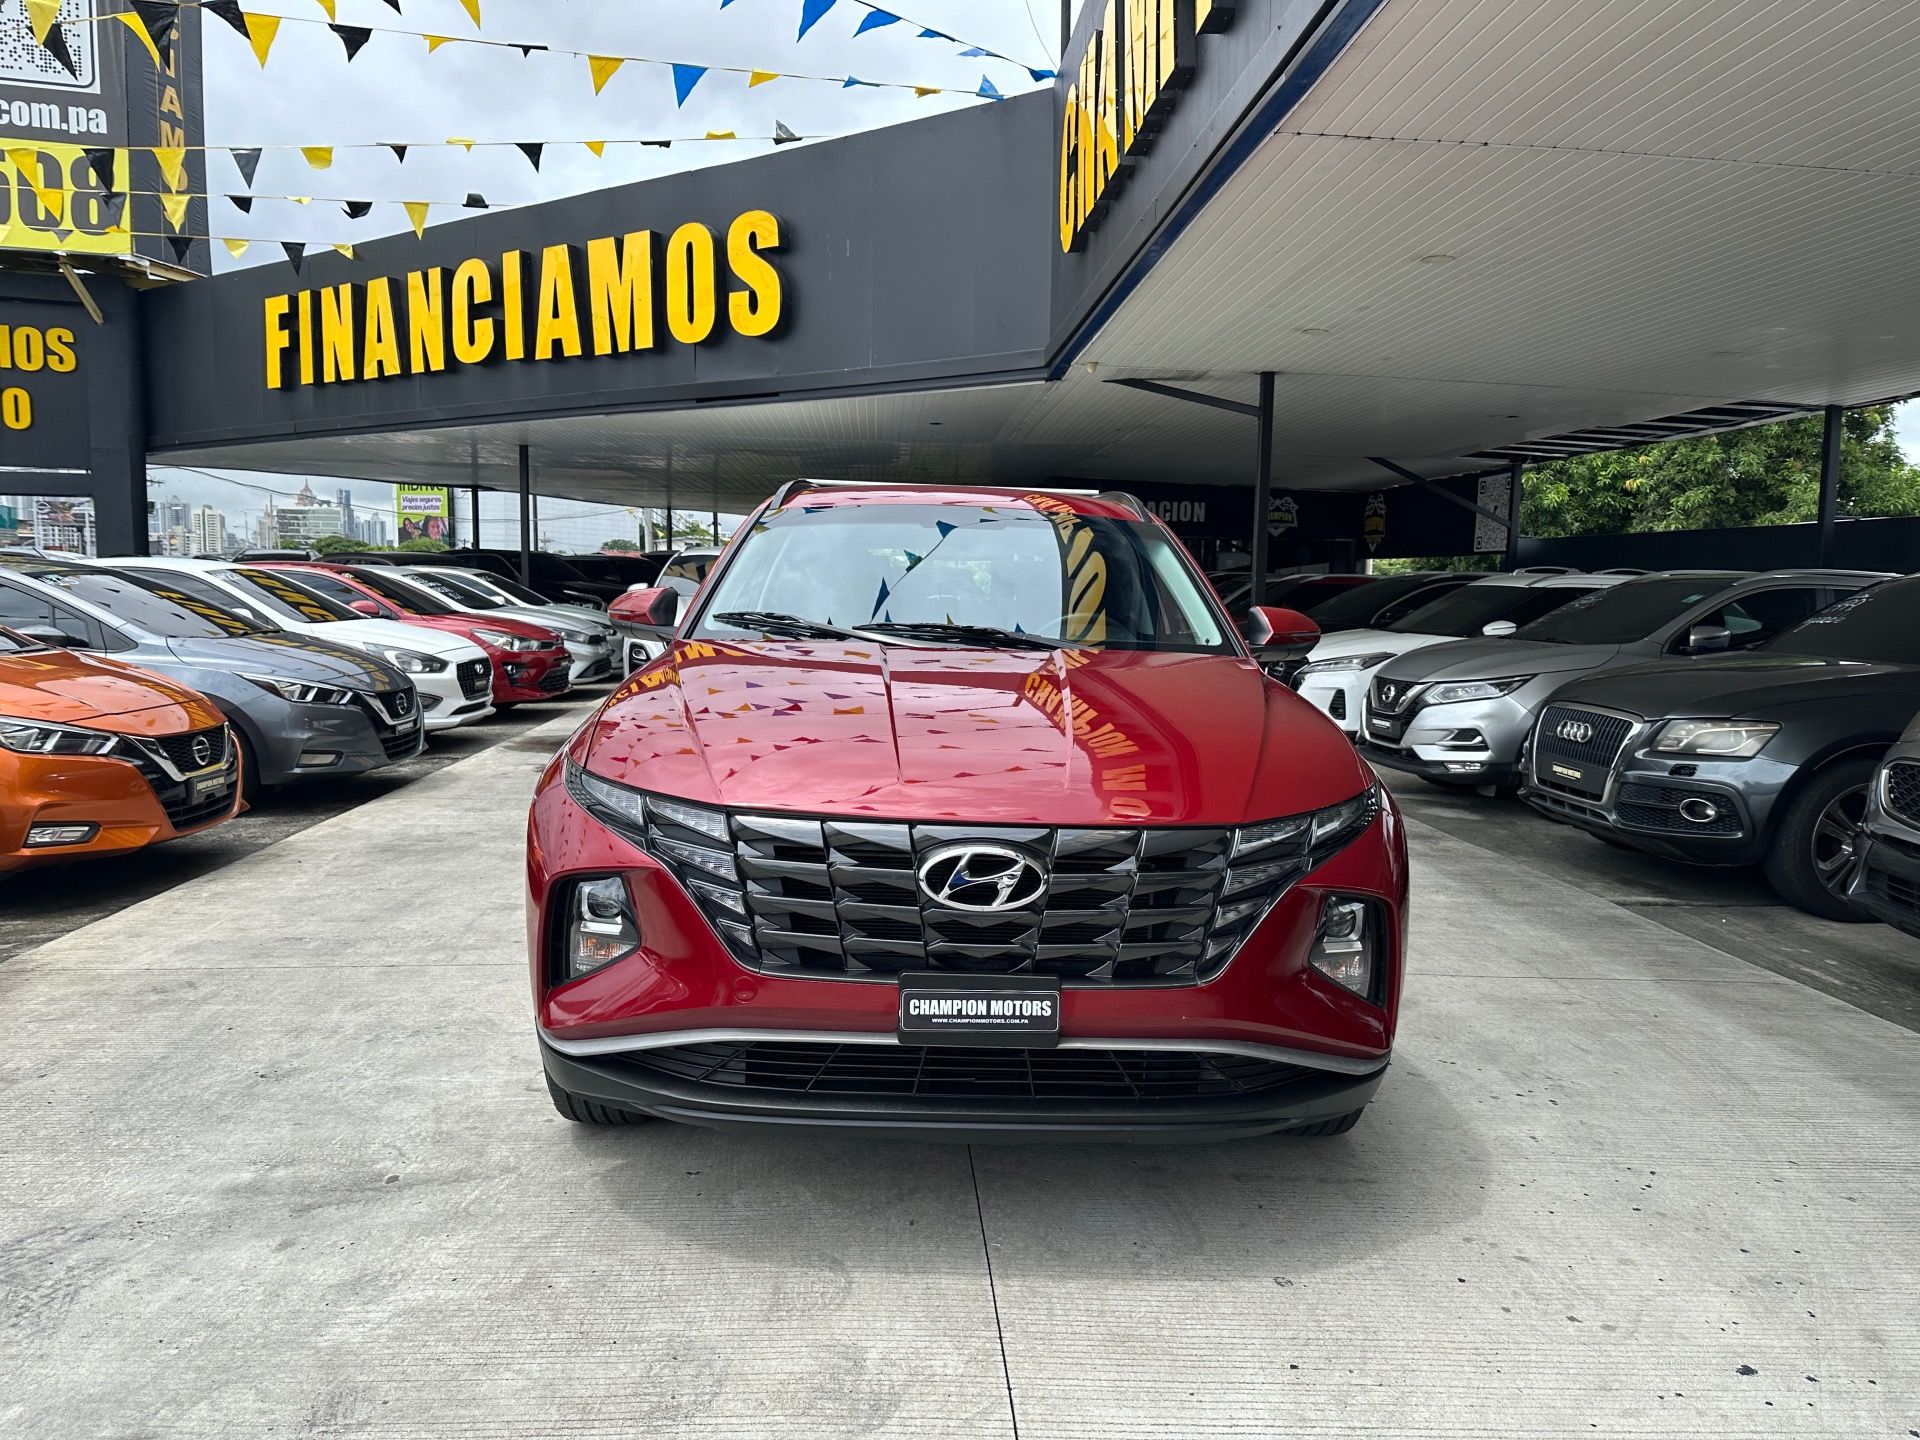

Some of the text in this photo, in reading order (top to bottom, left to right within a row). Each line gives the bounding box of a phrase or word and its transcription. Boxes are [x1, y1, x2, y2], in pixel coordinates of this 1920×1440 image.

[264, 209, 783, 389] FINANCIAMOS
[910, 999, 1051, 1016] CHAMPION MOTORS
